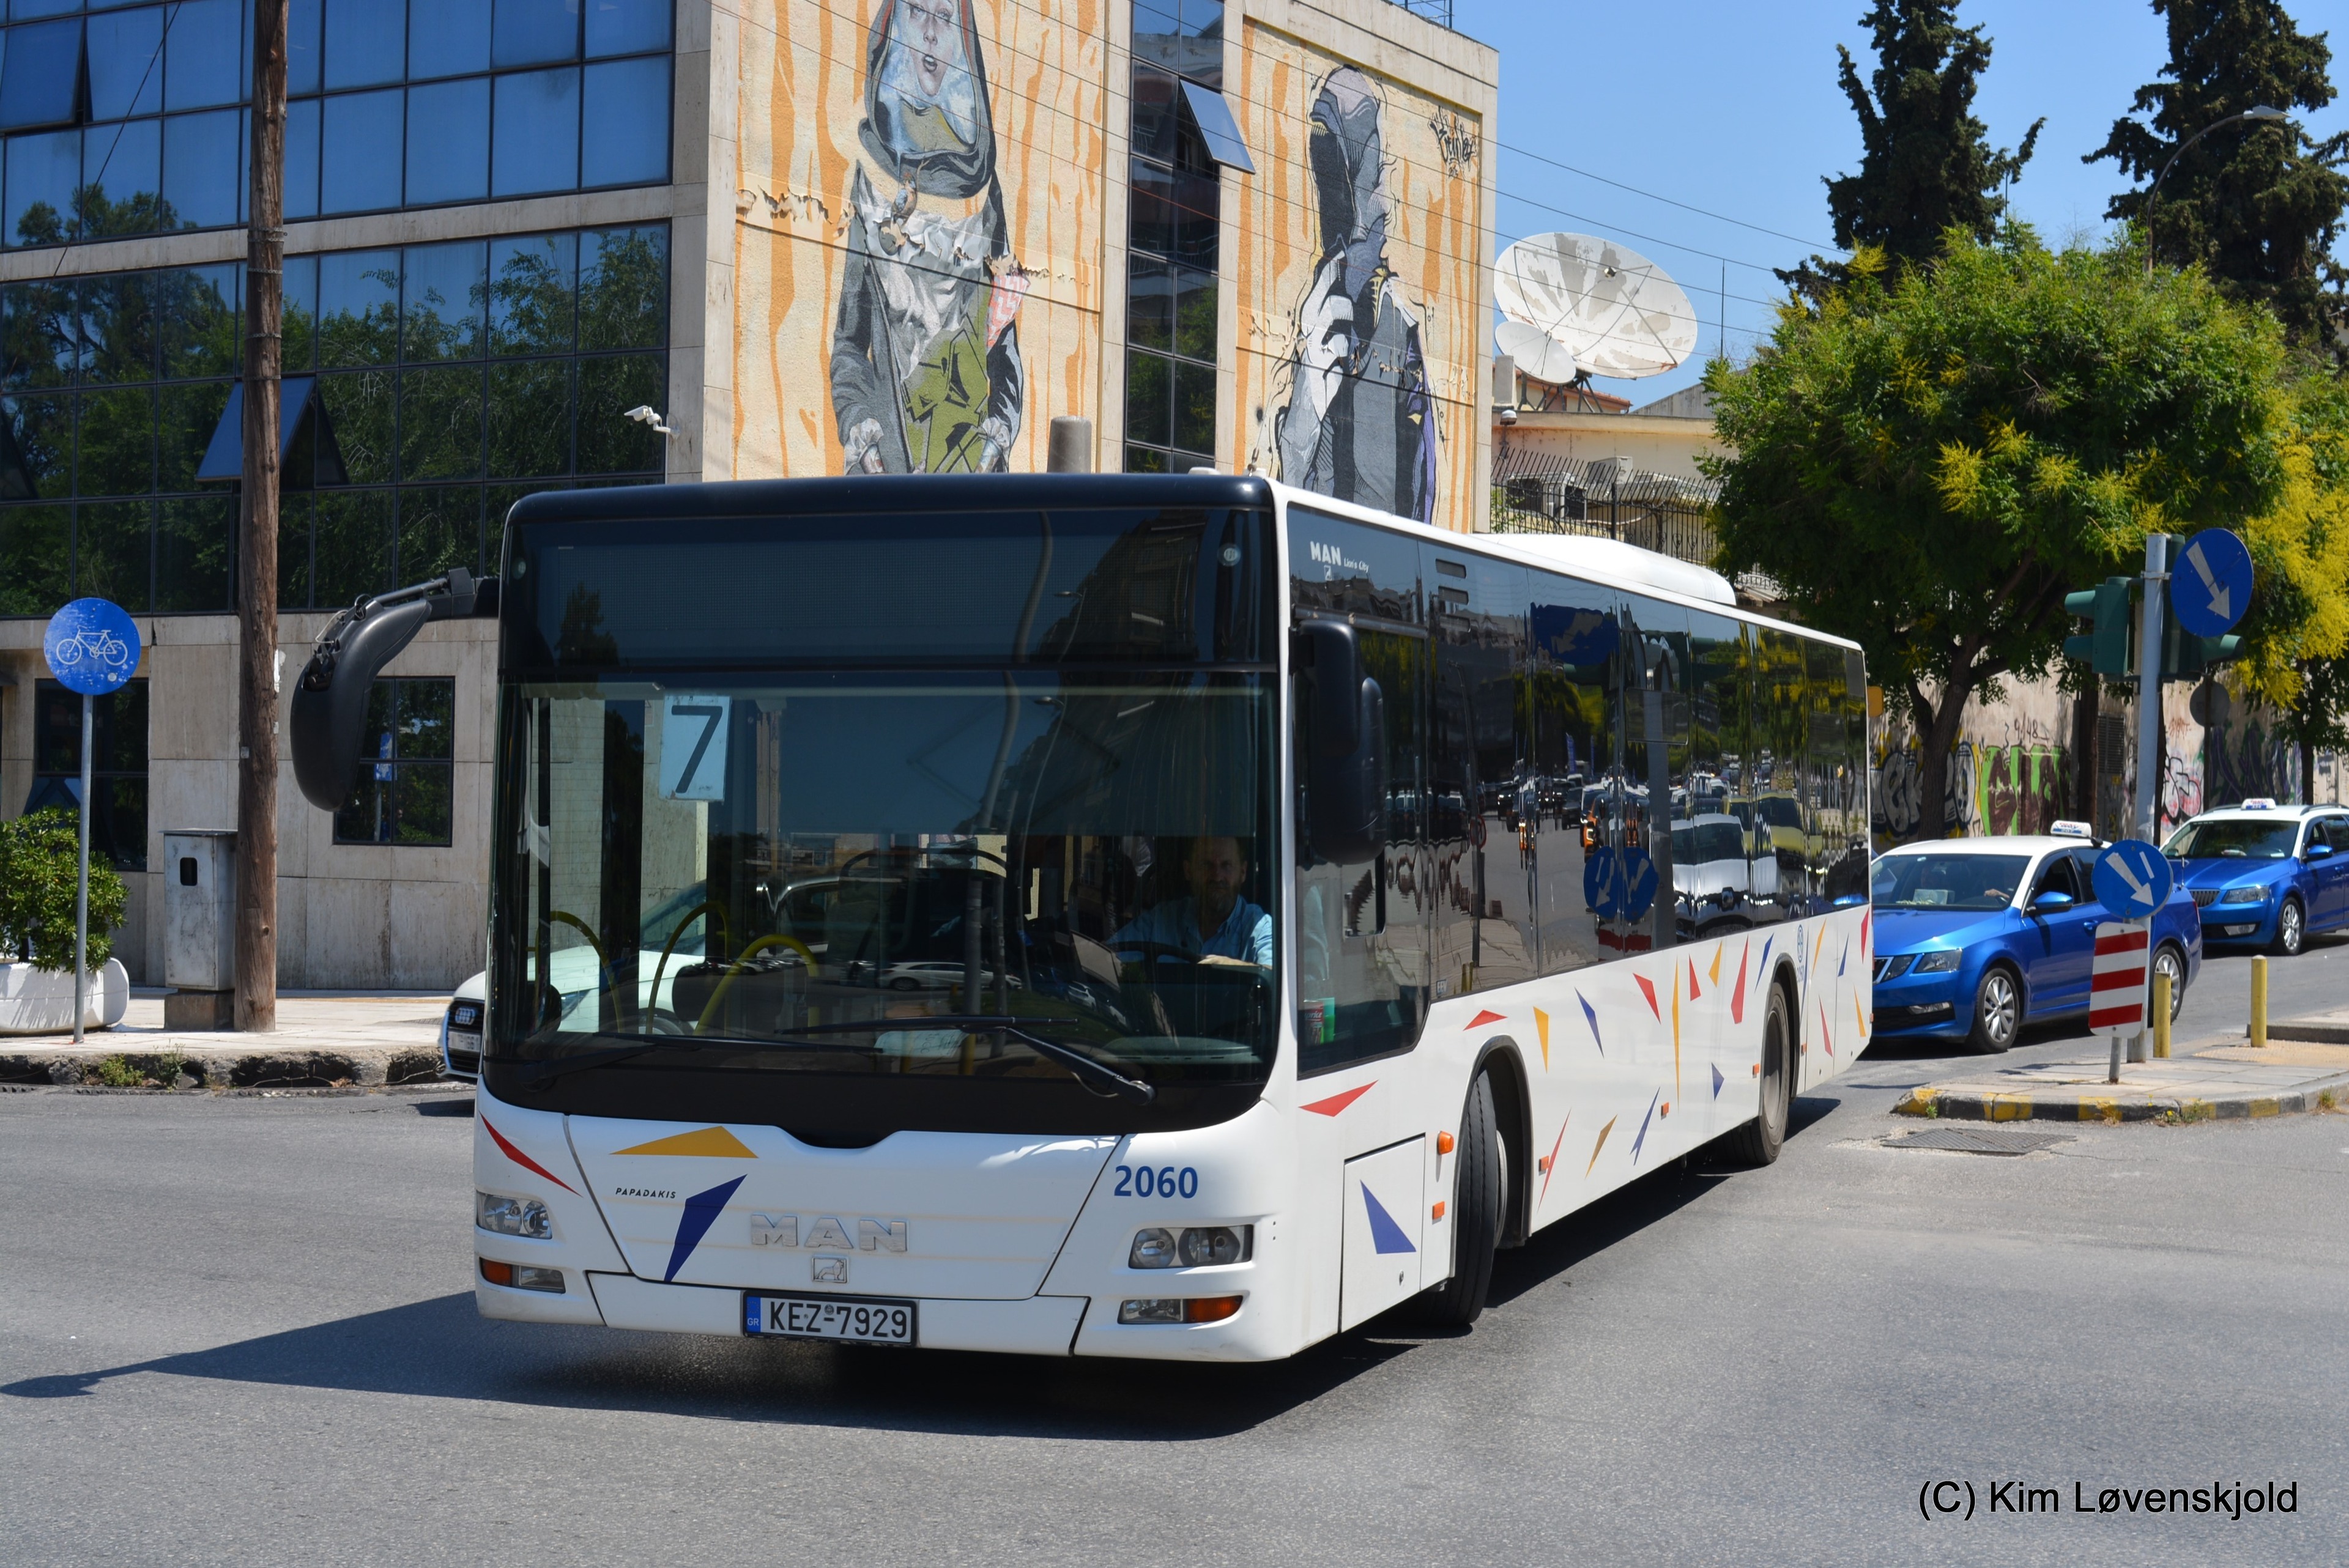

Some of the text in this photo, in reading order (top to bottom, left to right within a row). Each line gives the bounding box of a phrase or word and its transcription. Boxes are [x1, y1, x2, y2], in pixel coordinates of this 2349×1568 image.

[1310, 541, 1370, 574] MAN Lion's City
[671, 705, 722, 793] 7
[615, 1188, 676, 1199] PAPADAKIS
[1114, 1165, 1198, 1199] 2060
[751, 1214, 908, 1252] MAN
[770, 1301, 907, 1338] KEZ-7929
